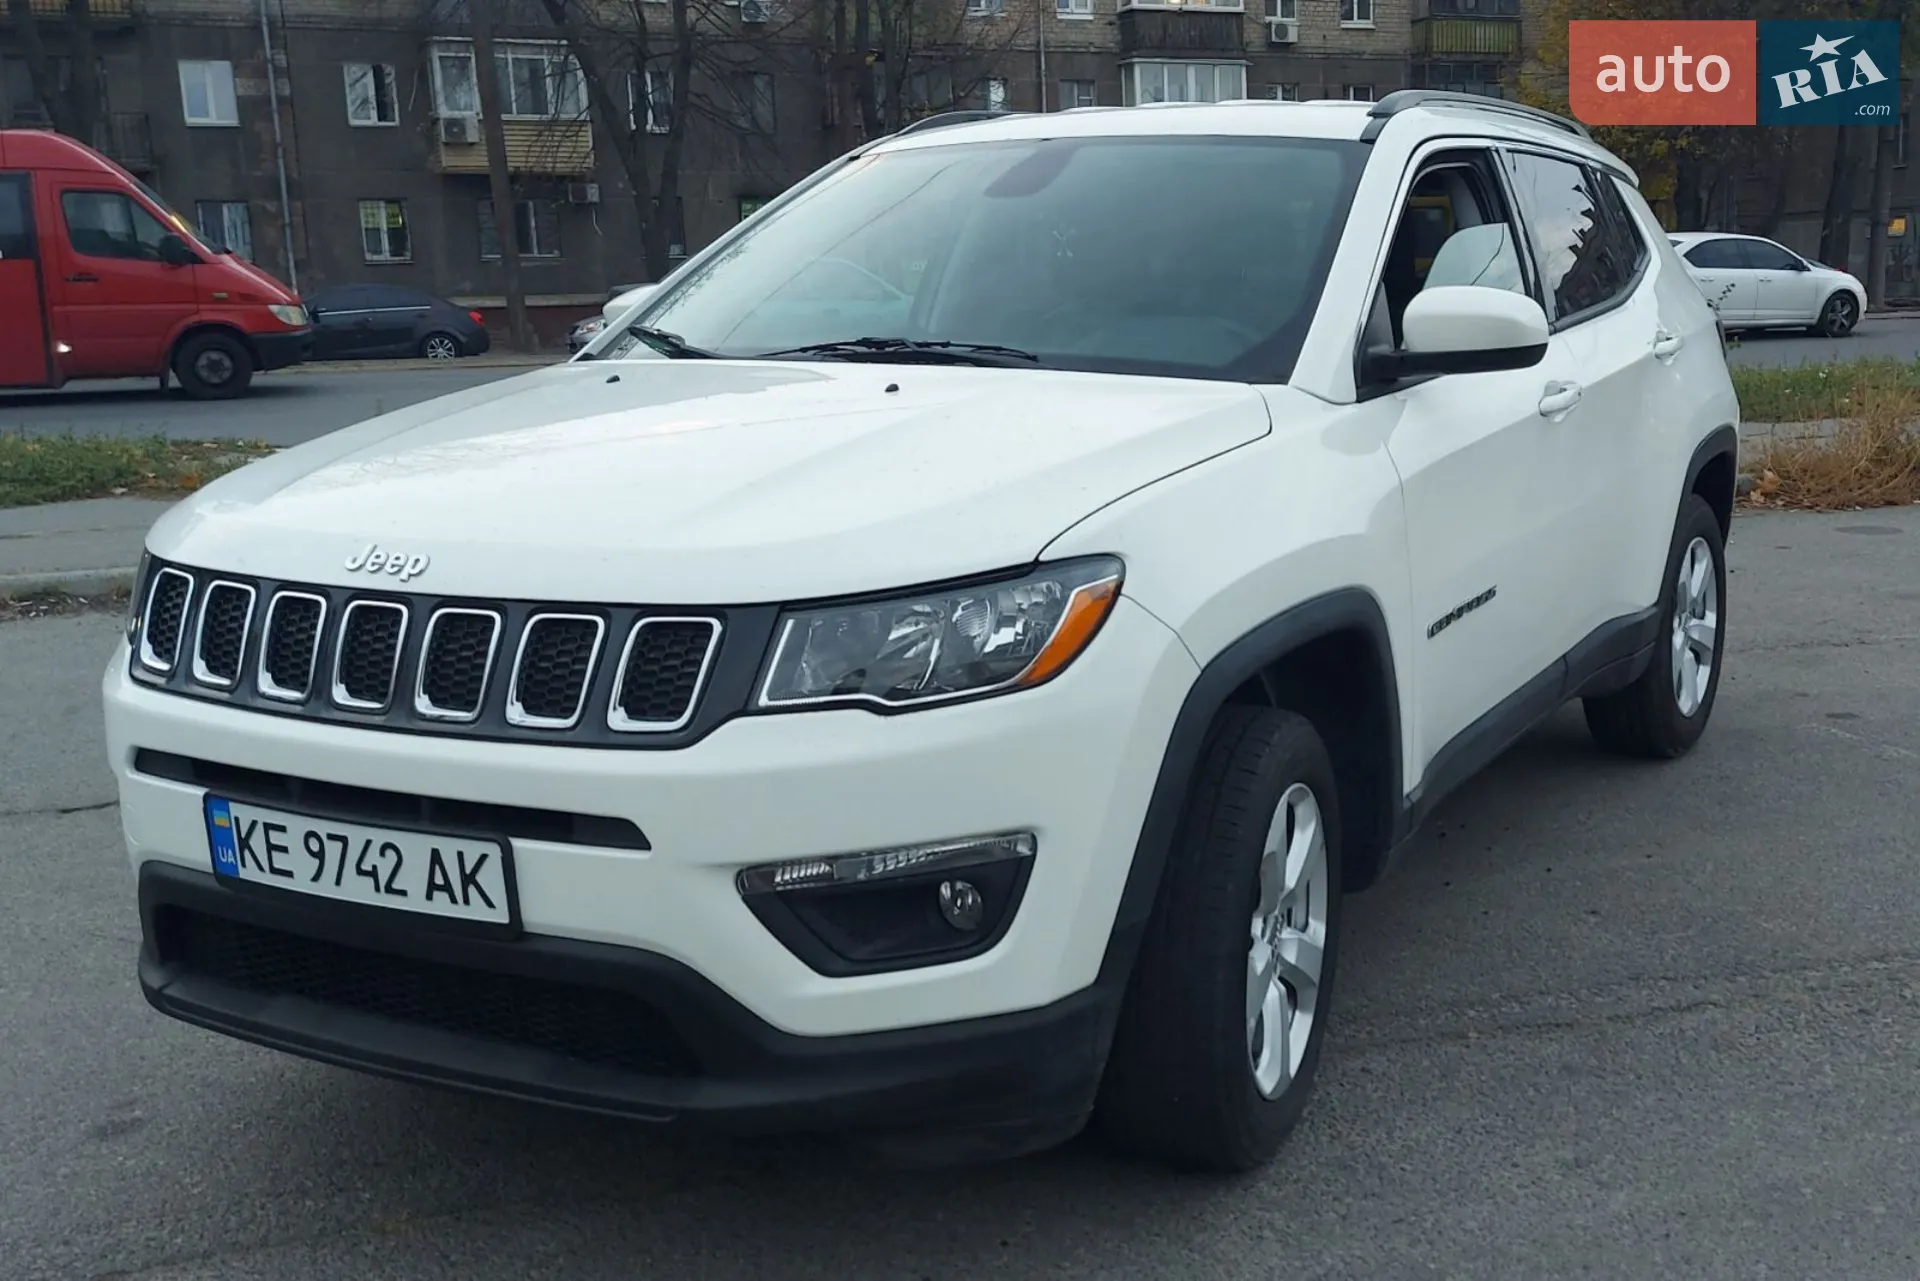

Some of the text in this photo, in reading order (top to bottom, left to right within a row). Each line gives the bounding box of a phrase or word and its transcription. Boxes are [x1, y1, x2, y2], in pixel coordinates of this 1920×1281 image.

[344, 544, 430, 583] Jeep
[218, 848, 236, 865] UA
[233, 815, 497, 909] KE 9742 AK
